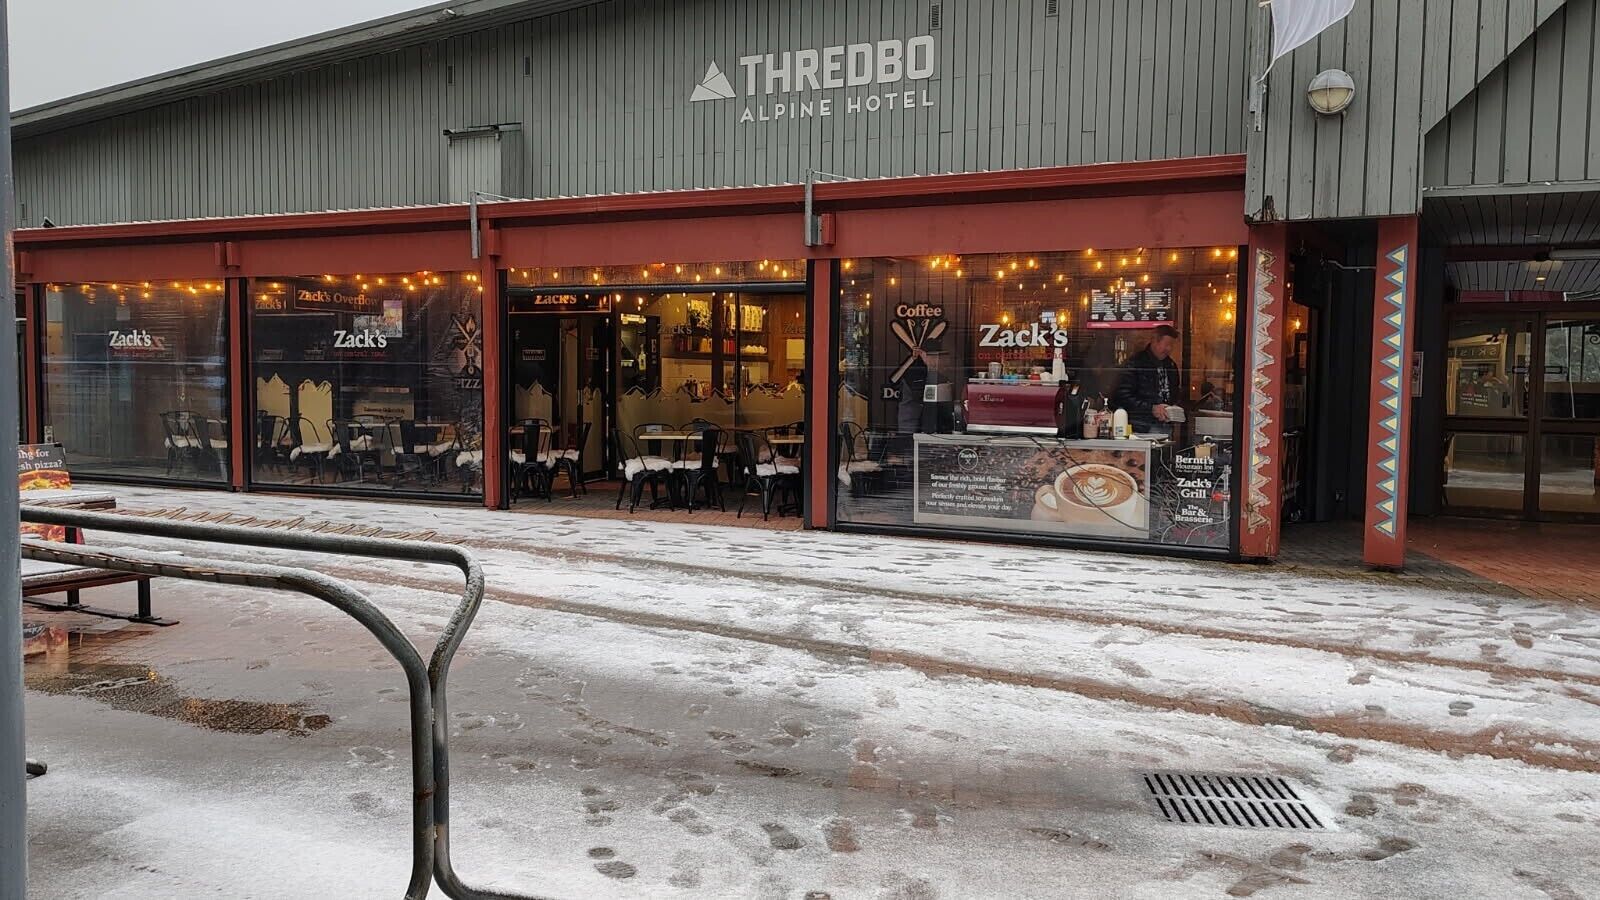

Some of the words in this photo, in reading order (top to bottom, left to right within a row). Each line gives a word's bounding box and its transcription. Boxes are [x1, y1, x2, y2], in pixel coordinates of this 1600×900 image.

[739, 35, 935, 96] THREDBO
[740, 99, 832, 123] ALPINE
[847, 89, 934, 114] HOTEL
[298, 289, 331, 303] Zack's
[896, 304, 942, 317] Coffee
[108, 329, 152, 347] Zack's
[333, 329, 387, 348] Zack's
[979, 322, 1068, 347] Zack's
[35, 447, 50, 457] for
[18, 460, 32, 470] sh
[34, 459, 63, 471] pizza?
[1175, 454, 1214, 465] Bernti's
[1177, 477, 1212, 489] Zack's
[1180, 488, 1206, 499] Grill
[1181, 508, 1197, 516] Bar
[1175, 514, 1214, 523] Brasserie
